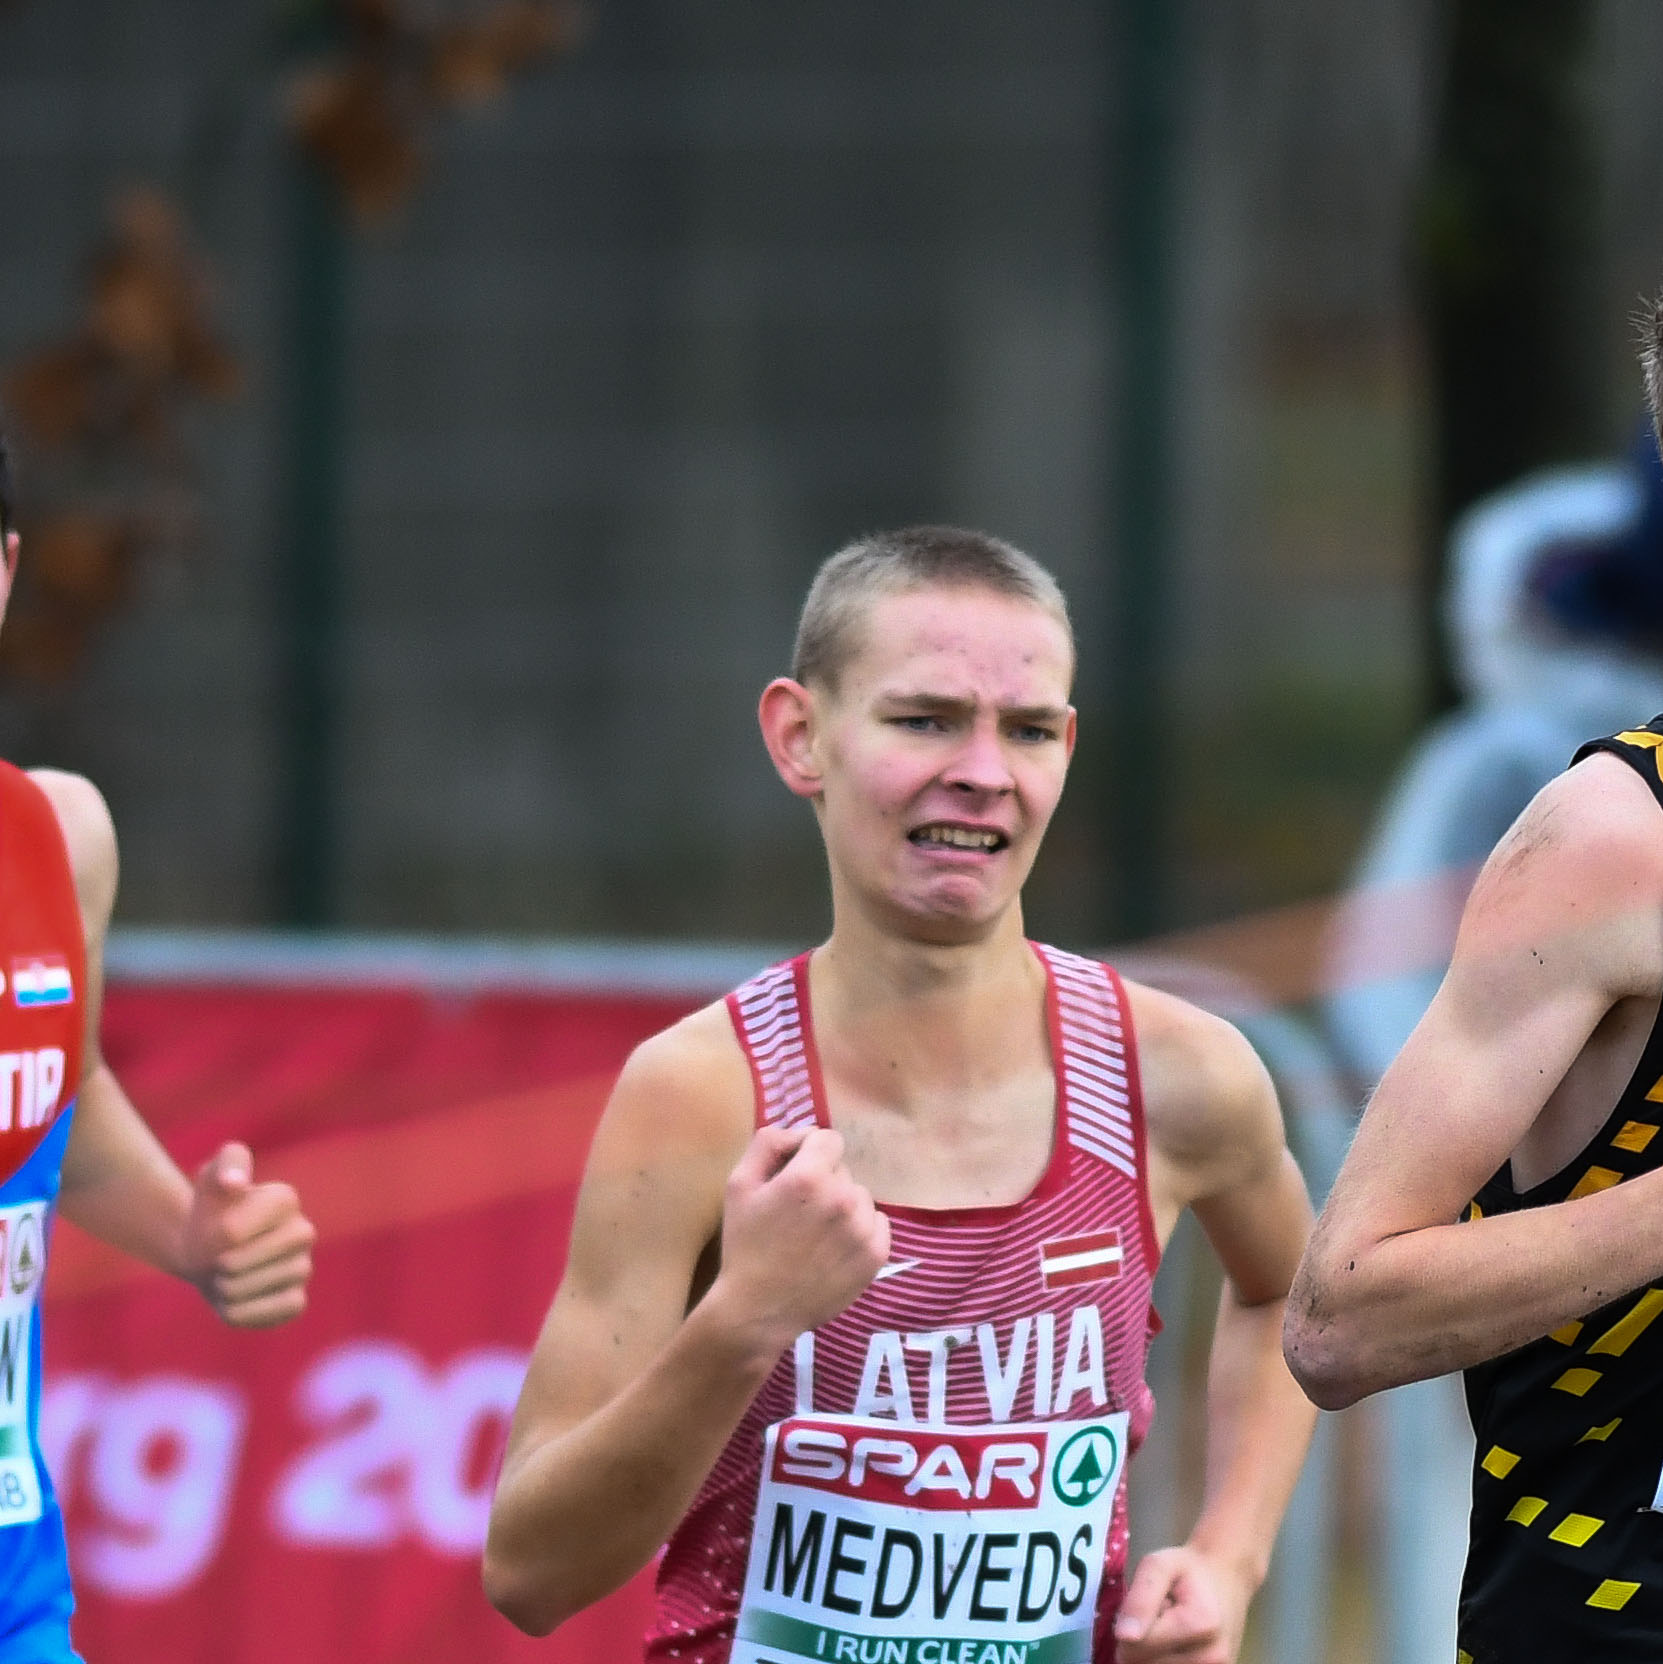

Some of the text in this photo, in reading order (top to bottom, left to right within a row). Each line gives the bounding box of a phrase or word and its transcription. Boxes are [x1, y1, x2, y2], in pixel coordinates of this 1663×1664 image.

[793, 1304, 1109, 1425] LATVIA
[781, 1428, 1041, 1500] SPAR
[763, 1502, 1093, 1623] MEDVEDS
[816, 1630, 826, 1655] I
